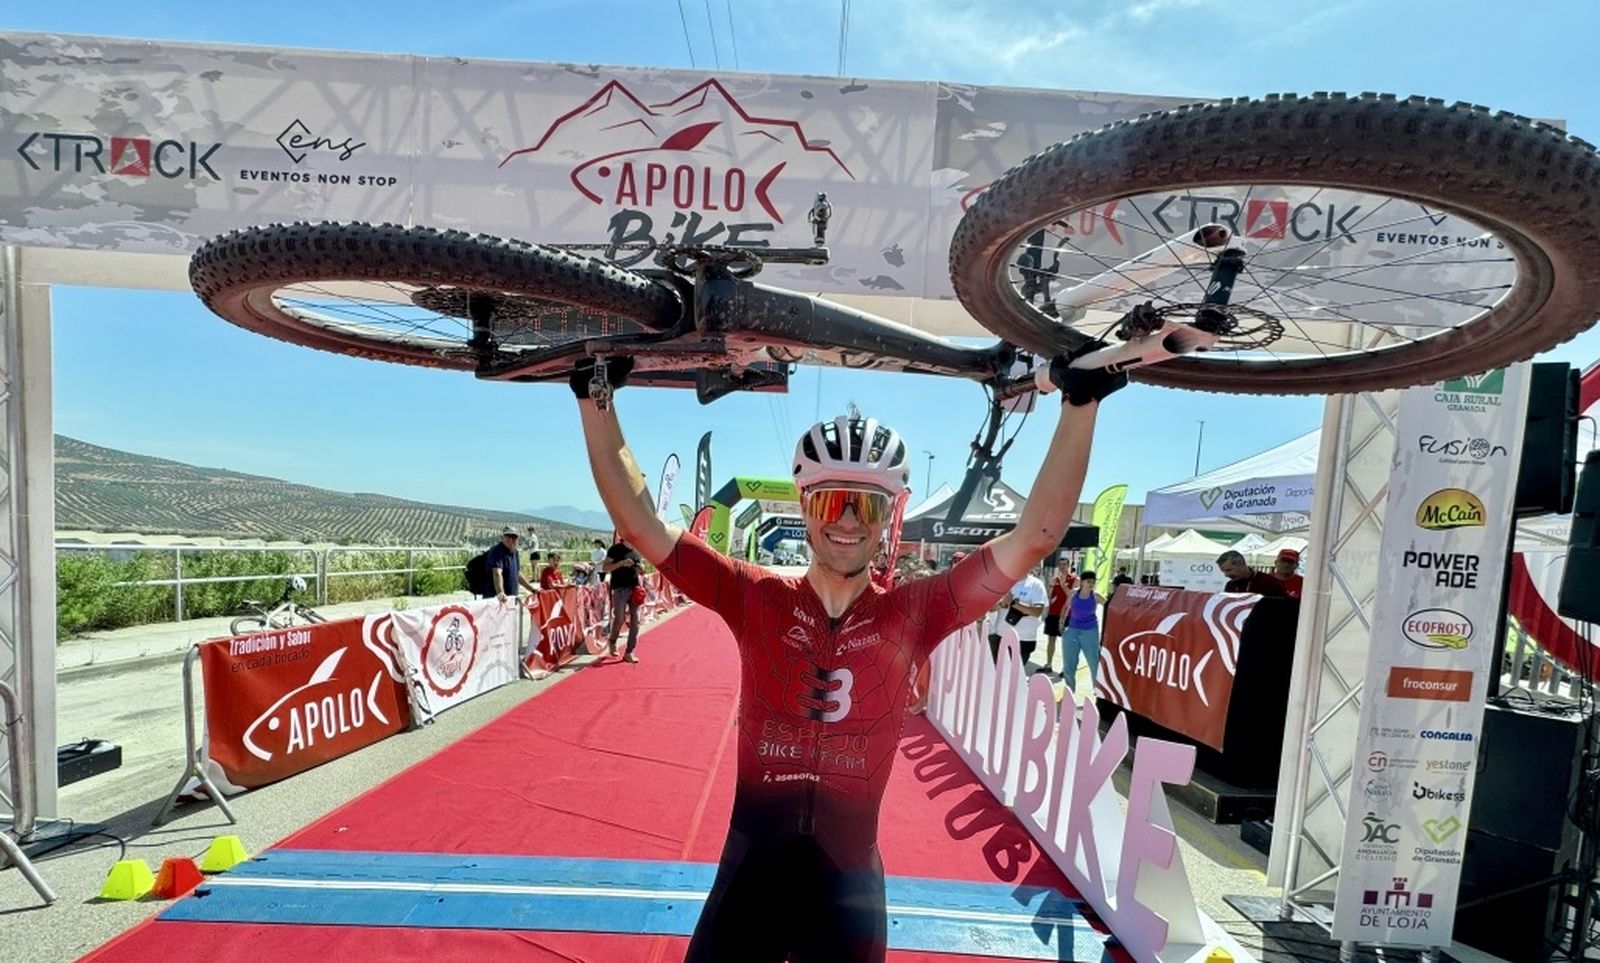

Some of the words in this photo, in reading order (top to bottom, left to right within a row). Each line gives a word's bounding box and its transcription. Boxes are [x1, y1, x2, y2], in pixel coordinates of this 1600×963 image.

[240, 169, 312, 184] EVENTOS
[318, 173, 351, 185] NON
[358, 175, 397, 187] STOP
[614, 162, 746, 213] APOLO
[1377, 232, 1449, 246] EVENTOS
[1434, 393, 1460, 404] CAJA
[1464, 395, 1502, 407] RURAL
[1224, 484, 1276, 500] Diputación
[1222, 502, 1235, 511] de
[1235, 496, 1277, 510] Granada
[1421, 502, 1482, 525] McCain
[945, 526, 1006, 536] SCOTT
[1402, 550, 1480, 572] POWER
[1435, 570, 1477, 589] ADE
[1407, 620, 1469, 636] ECOFROST
[230, 631, 277, 656] Tradición
[279, 634, 286, 651] y
[287, 630, 312, 647] Sabor
[1134, 648, 1190, 692] APOLO
[1403, 677, 1458, 692] froconsur
[287, 687, 365, 755] APOLO
[758, 740, 802, 759] BIKE
[1360, 906, 1432, 919] AYUNTAMIENTO
[1360, 914, 1381, 928] DE
[1387, 916, 1429, 930] LOJA
